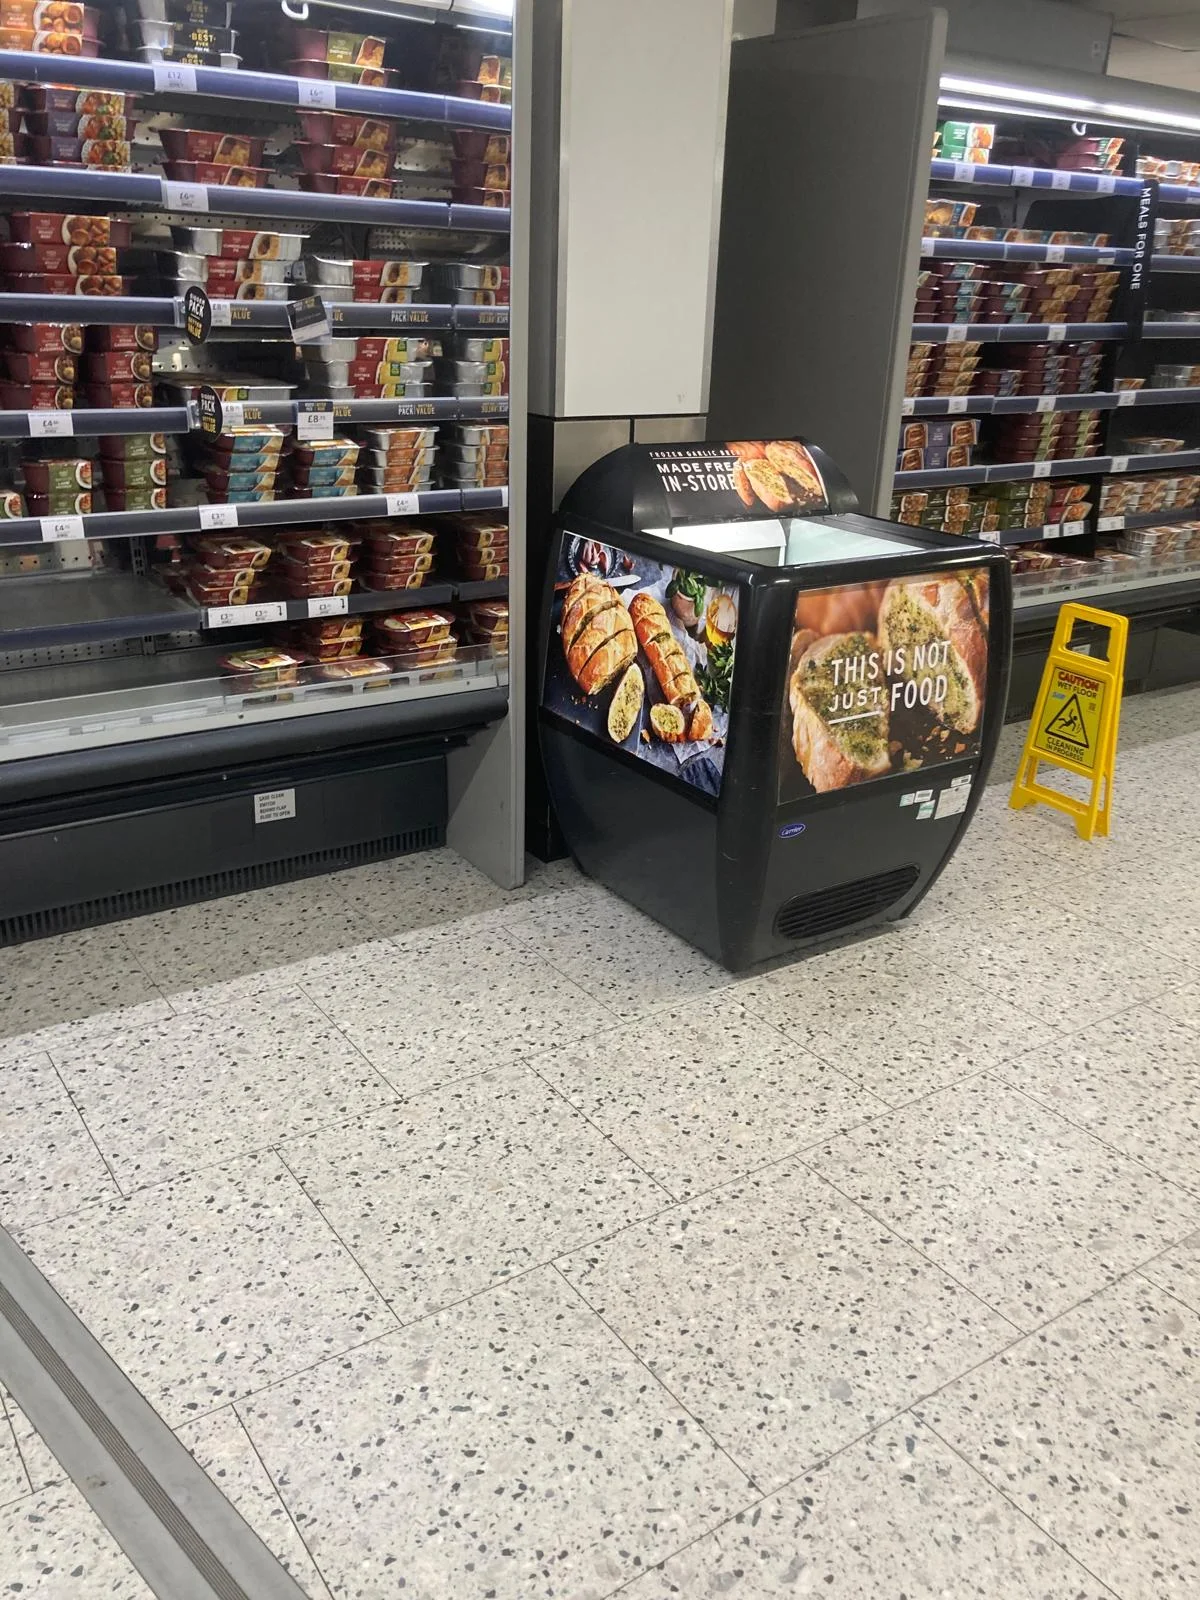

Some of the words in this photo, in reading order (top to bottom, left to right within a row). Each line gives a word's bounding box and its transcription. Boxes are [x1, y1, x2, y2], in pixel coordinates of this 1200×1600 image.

[192, 32, 214, 42] BEST
[1138, 187, 1151, 229] MEALS
[1135, 233, 1146, 259] FOR
[1131, 263, 1143, 289] ONE
[188, 300, 204, 318] PACK
[391, 313, 406, 322] PACK
[410, 314, 429, 322] VALUE
[188, 322, 202, 339] VALUE
[201, 399, 215, 413] PACK
[398, 407, 414, 416] PACK
[416, 406, 435, 415] VALUE
[244, 410, 262, 419] ALUE
[202, 421, 216, 434] VALUE
[656, 462, 702, 474] MADE
[705, 462, 752, 472] FRESH
[661, 474, 738, 492] IN-STORE
[831, 652, 880, 686] THIS
[886, 647, 906, 676] IS
[913, 640, 952, 672] NOT
[1057, 682, 1072, 690] WET
[1073, 687, 1097, 698] FLOOR
[1058, 672, 1099, 692] CAUTION
[828, 686, 882, 712] JUST
[890, 674, 948, 712] FOOD
[1047, 736, 1084, 756] CLEANING
[1052, 746, 1083, 761] PROGRESS
[781, 826, 803, 836] Carrier
